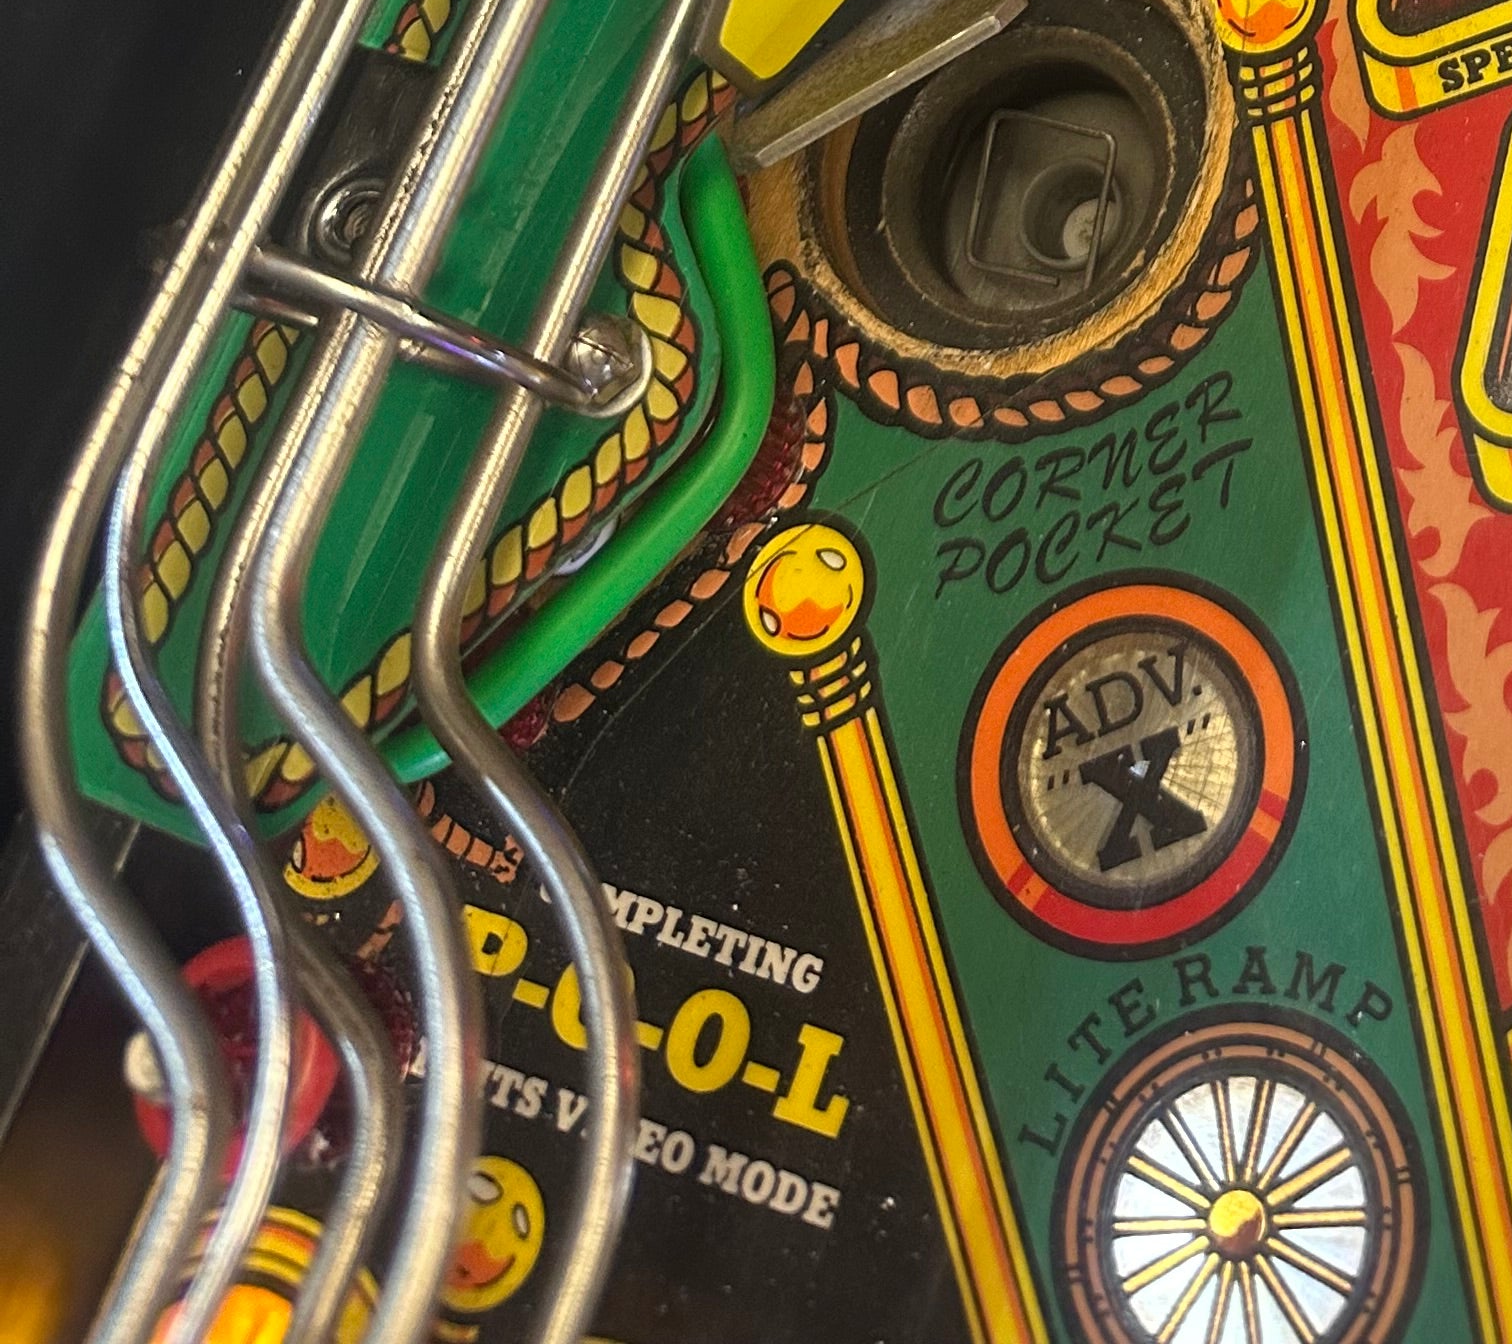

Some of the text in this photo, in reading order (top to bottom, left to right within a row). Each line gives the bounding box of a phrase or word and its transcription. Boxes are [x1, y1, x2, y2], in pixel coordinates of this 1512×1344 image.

[933, 370, 1243, 529] CORNER
[934, 437, 1254, 599] POCKET
[1042, 640, 1203, 762] ADV.
[539, 882, 825, 994] MPLETING
[1018, 946, 1394, 1158] LITE RAMP
[556, 1089, 842, 1231] VEO MODE
